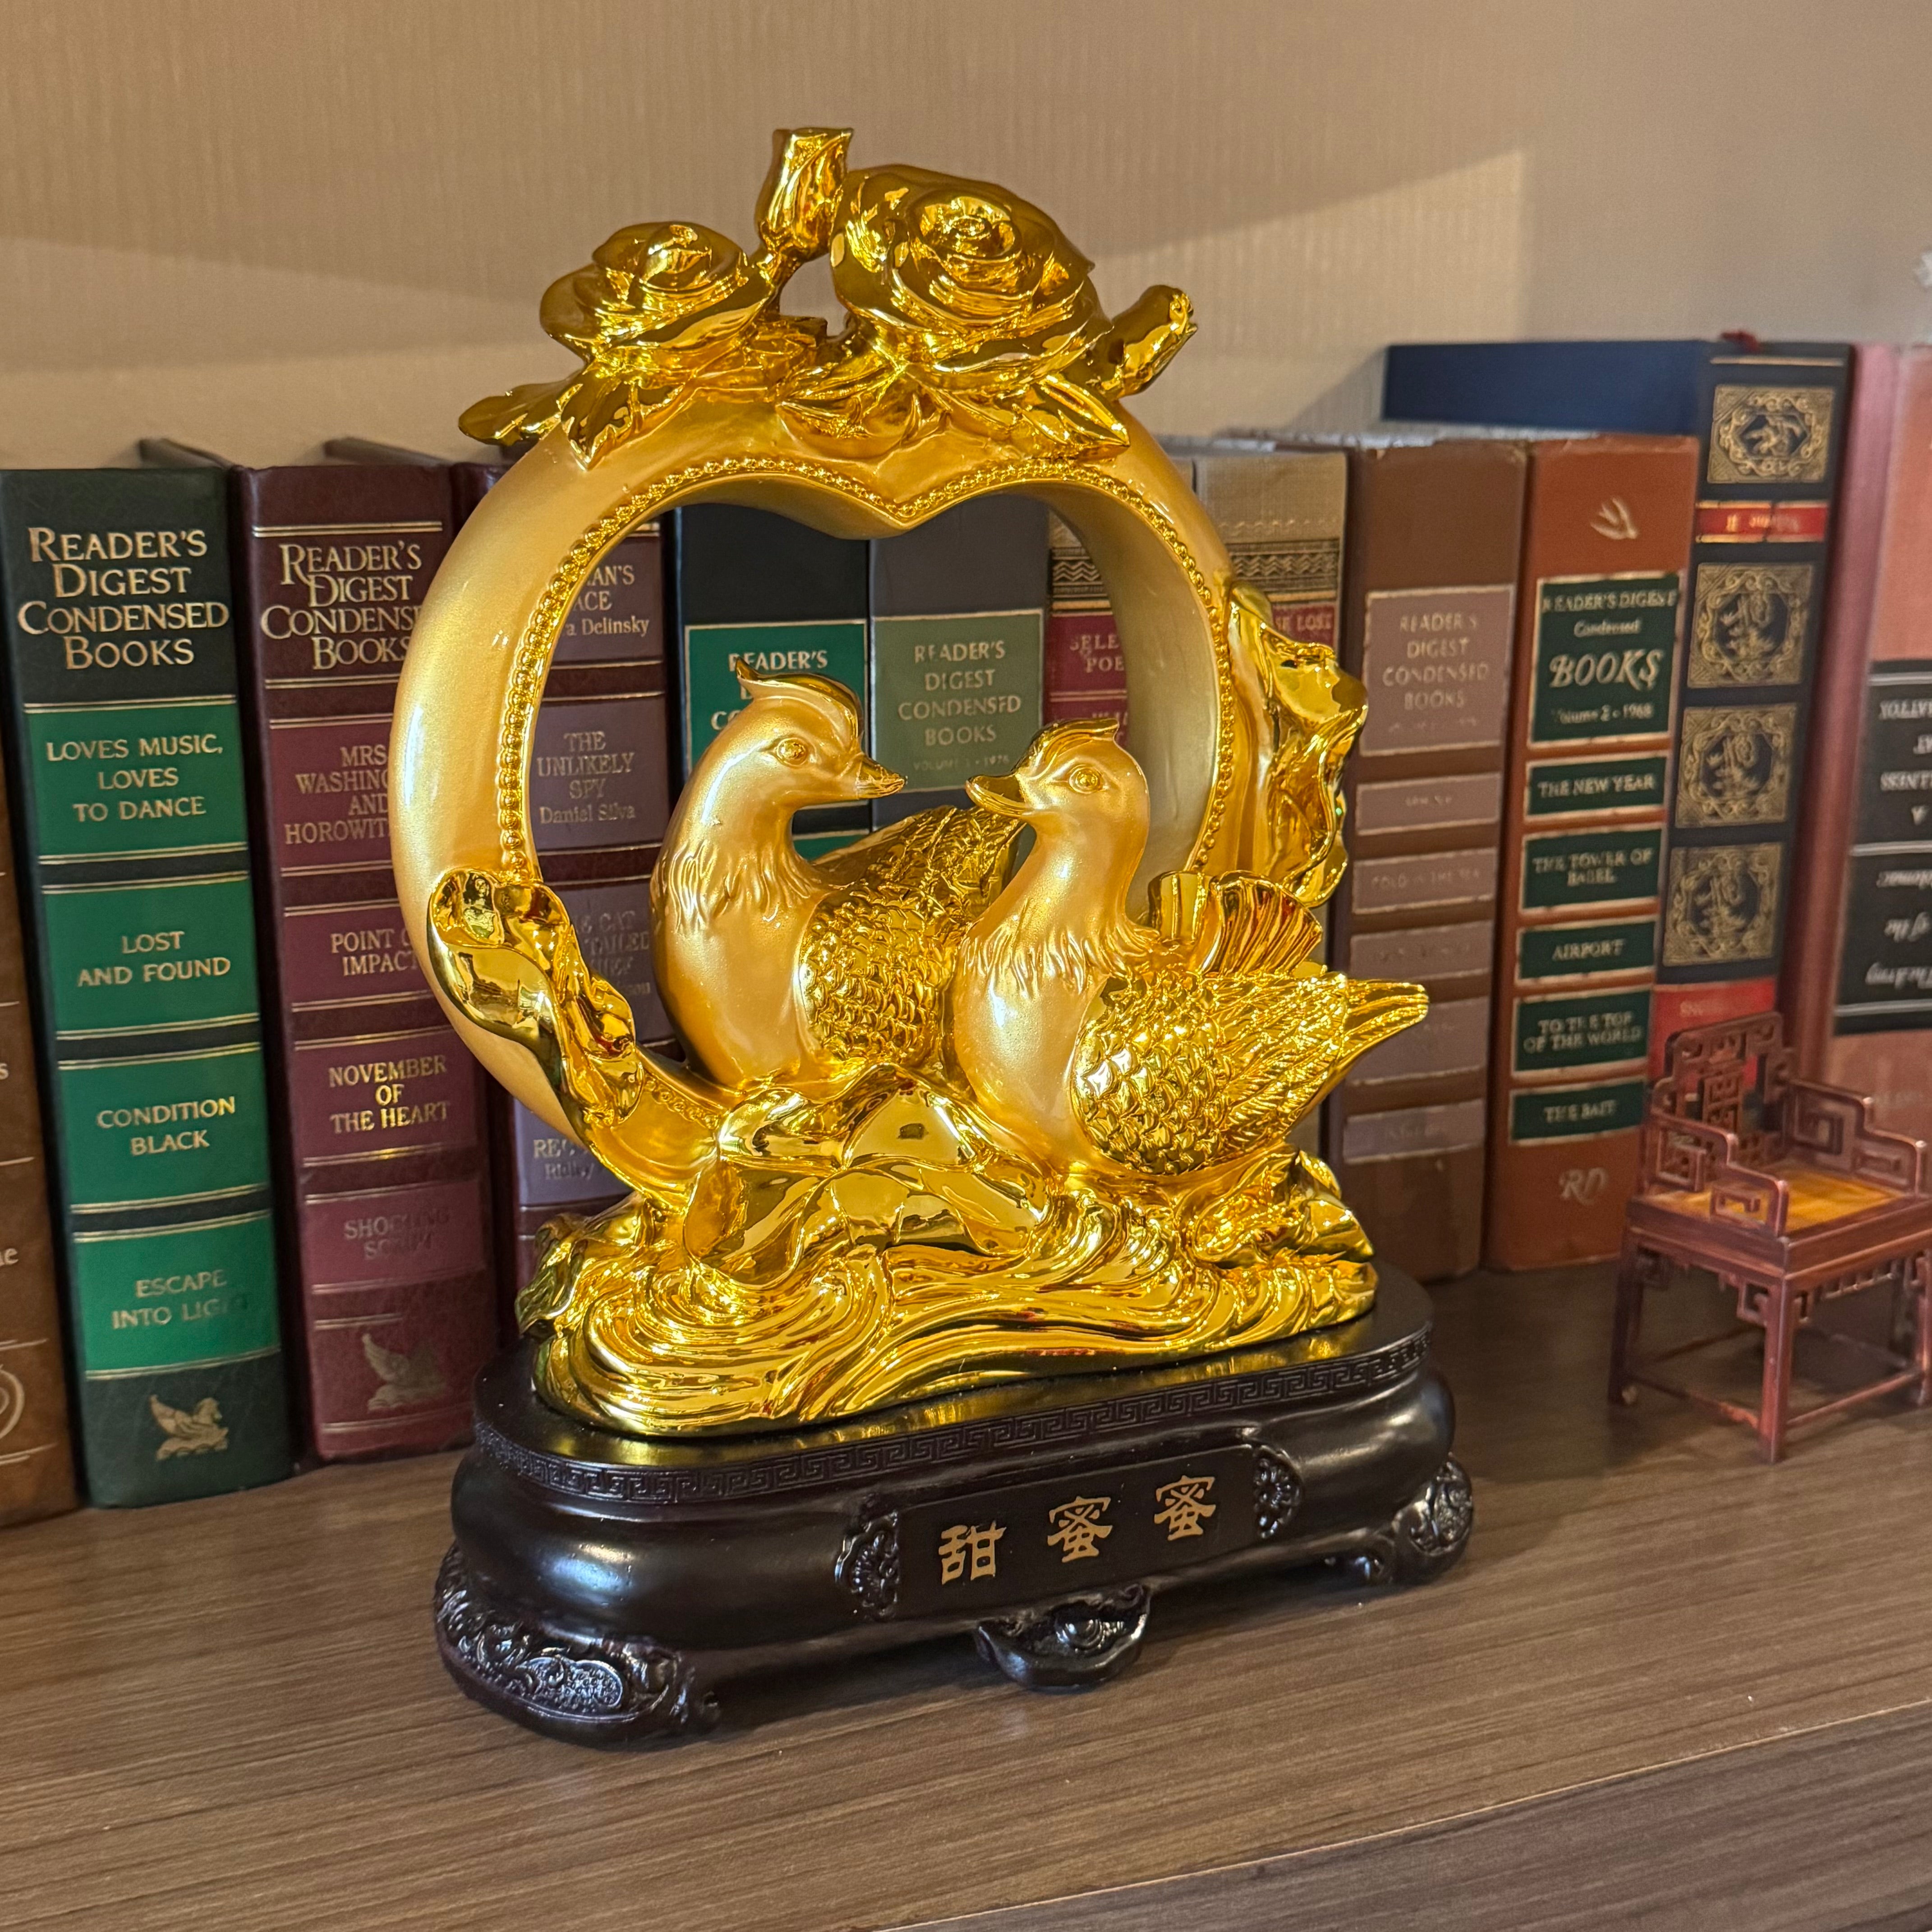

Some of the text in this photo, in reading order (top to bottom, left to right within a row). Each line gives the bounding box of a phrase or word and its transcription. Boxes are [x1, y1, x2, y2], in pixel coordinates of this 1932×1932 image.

[28, 527, 207, 562] READER'S
[279, 540, 422, 589] READER'S
[586, 565, 635, 586] AN'S
[52, 563, 192, 598] DIGEST
[308, 574, 413, 607] DIGEST
[17, 601, 229, 635] CONDENSED
[261, 605, 422, 639] CONDENS
[582, 616, 649, 637] Delinsky
[1574, 618, 1640, 637] Condensed
[64, 636, 194, 670] BOOKS
[915, 640, 1006, 663] READER'S
[1407, 637, 1469, 658] DIGEST
[925, 670, 995, 691] DIGEST
[1382, 662, 1487, 686] CONDENSED
[1550, 649, 1664, 691] BOOKS
[898, 695, 1021, 720] CONDENSED
[1404, 690, 1464, 710] BOOKS
[46, 734, 223, 761] LOVES MUSIC,
[564, 731, 606, 752] THE
[925, 725, 996, 746] BOOKS
[537, 752, 635, 777] UNLIKELY
[97, 768, 179, 789] LOVES
[569, 778, 606, 799] SPY
[1538, 774, 1655, 798] THE NEW YEAR
[73, 796, 207, 822] TO DANCE
[540, 804, 593, 824] Daniel
[284, 818, 390, 845] HOROWIT
[1533, 857, 1565, 874] THE
[1630, 848, 1653, 865] OF
[122, 931, 184, 954] LOST
[331, 929, 395, 954] POINT
[1552, 939, 1625, 961] AIRPORT
[78, 957, 231, 988] AND FOUND
[1538, 1019, 1564, 1035] TO
[1523, 1035, 1547, 1054] OF
[1551, 1033, 1585, 1051] THE
[328, 1055, 447, 1088] NOVEMBER
[376, 1083, 405, 1106] OF
[96, 1096, 235, 1129] CONDITION
[330, 1100, 450, 1134] THE HEART
[1581, 1099, 1617, 1119] BAIT
[130, 1129, 209, 1156] BLACK
[136, 1270, 227, 1298] ESCAPE
[111, 1307, 172, 1329] INTO
[938, 1475, 1216, 1585] 甜蜜蜜
